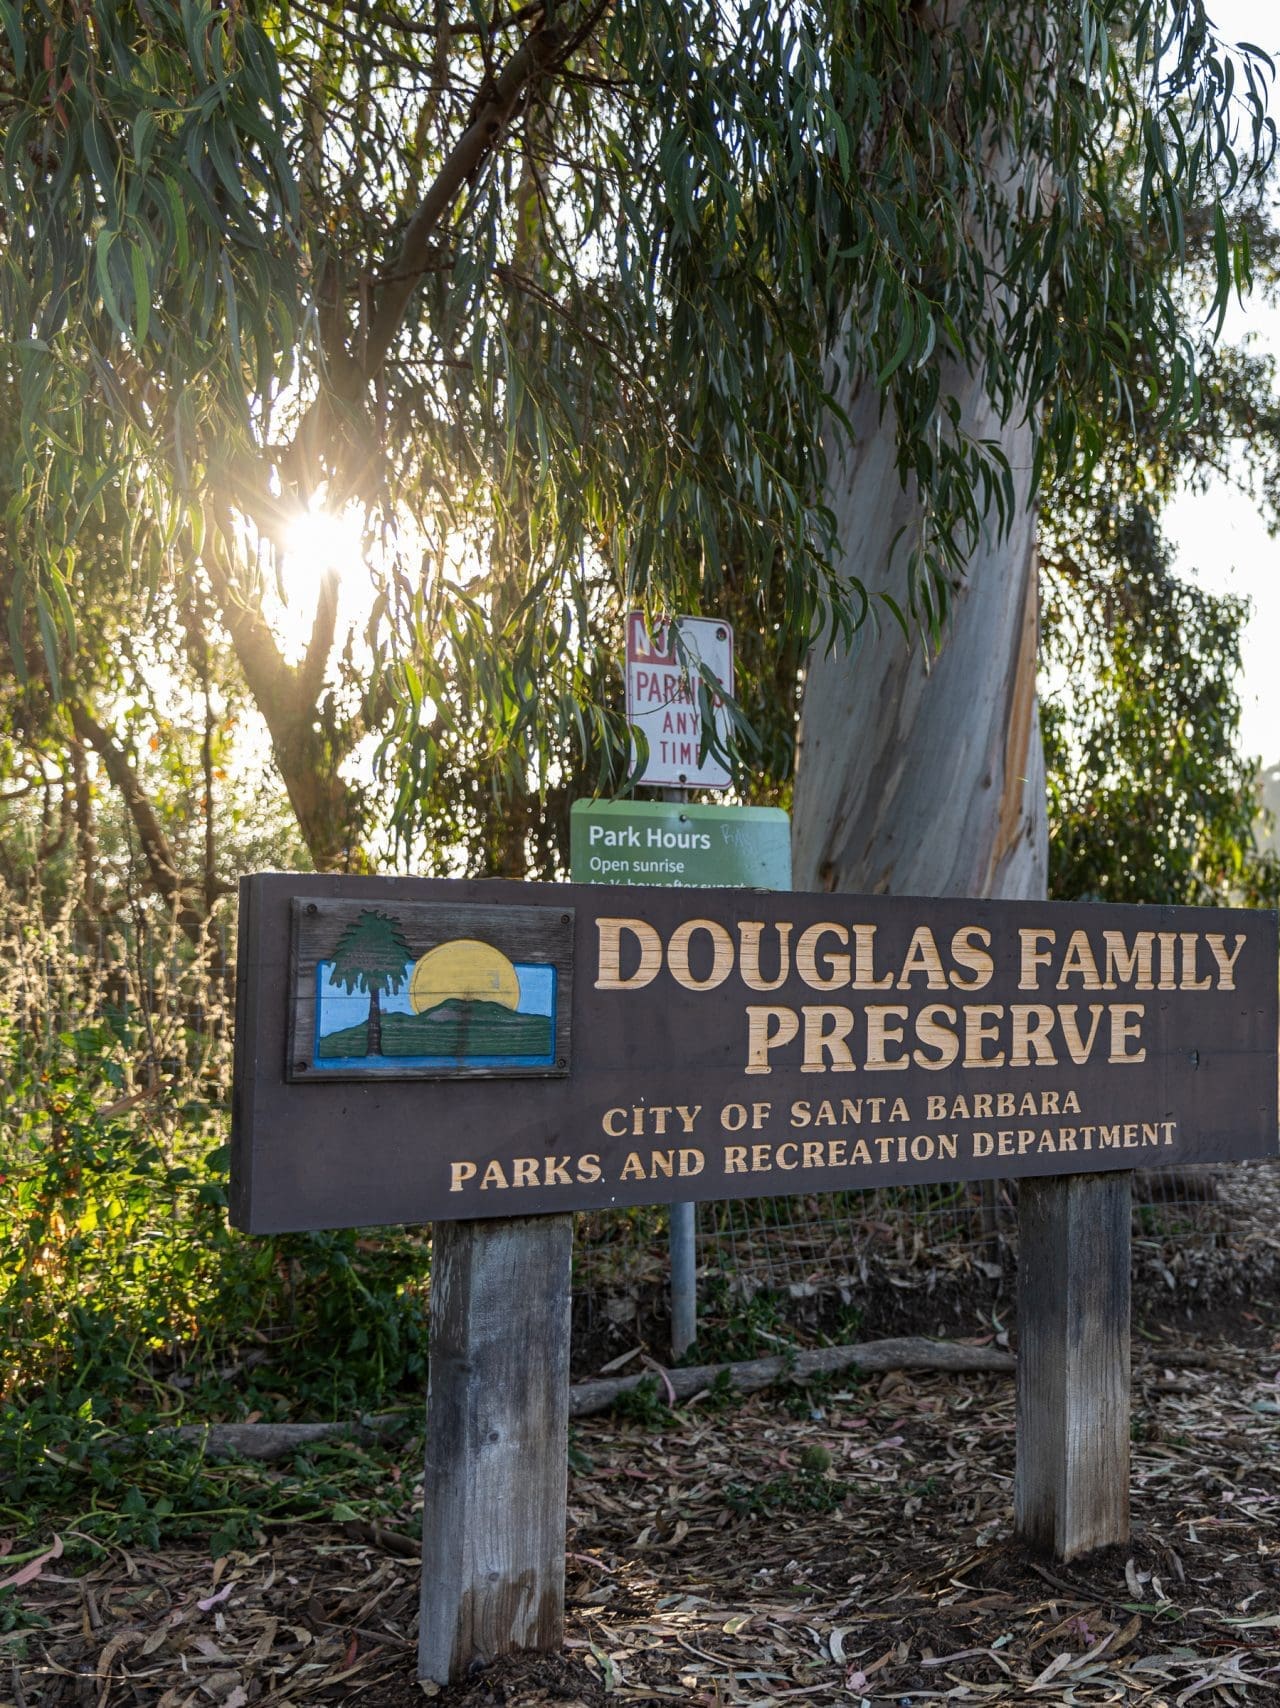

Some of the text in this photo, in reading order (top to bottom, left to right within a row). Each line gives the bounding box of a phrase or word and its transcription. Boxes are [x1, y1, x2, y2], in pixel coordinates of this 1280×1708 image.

[663, 711, 699, 735] ANY
[589, 825, 641, 847] Park
[647, 828, 711, 849] Hours
[590, 856, 684, 874] Open sunrise
[594, 918, 1247, 991] DOUGLAS FAMILY
[745, 1004, 1146, 1074] PRESERVE
[602, 1090, 1081, 1137] CITY OF SANTA BARBARA
[449, 1122, 1177, 1192] PARKS AND RECREATION DEPARTMENT
